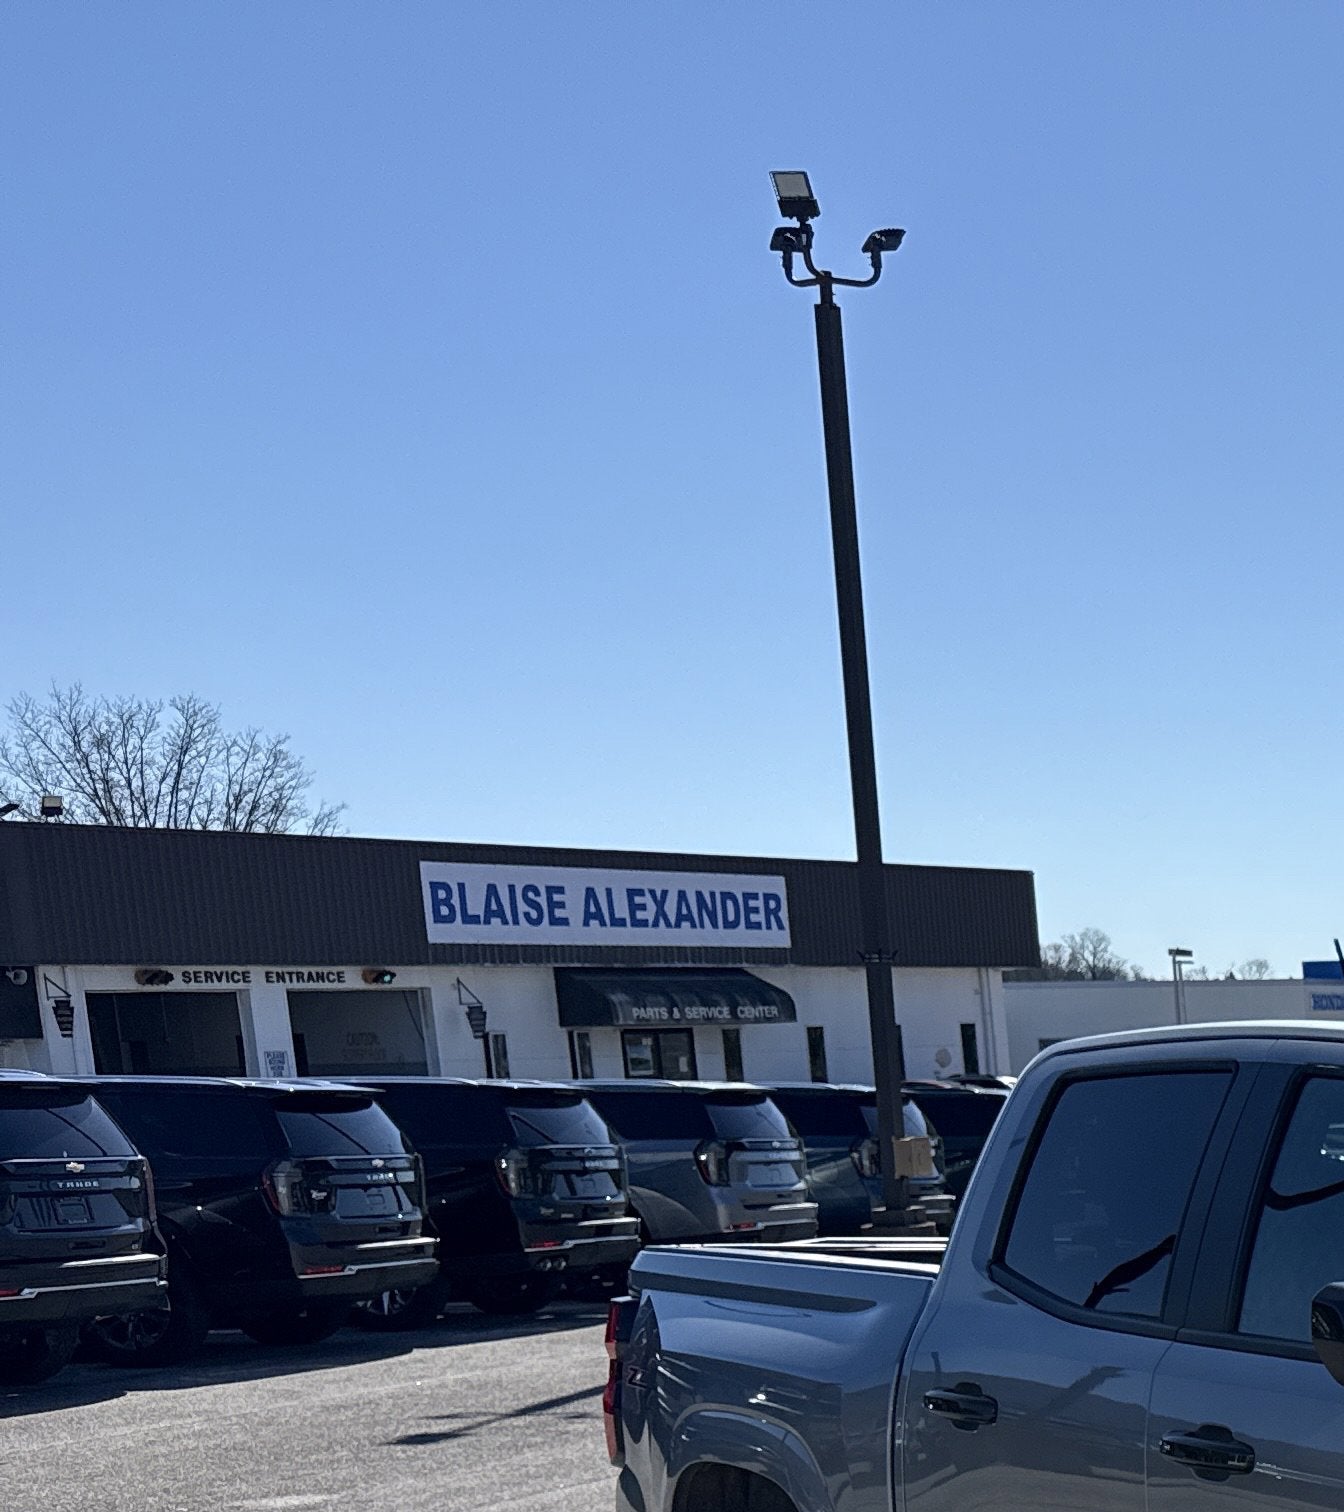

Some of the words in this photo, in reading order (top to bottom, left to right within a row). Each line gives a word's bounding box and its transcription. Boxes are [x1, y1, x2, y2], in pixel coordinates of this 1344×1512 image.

[428, 880, 570, 927] BLAISE
[582, 887, 786, 931] ALEXANDER
[181, 970, 252, 984] SERVICE
[265, 970, 346, 984] ENTRANCE
[632, 1006, 668, 1019] PARTS
[673, 1006, 681, 1019] &
[685, 1006, 731, 1019] SERVICE
[737, 1005, 779, 1018] CENTER
